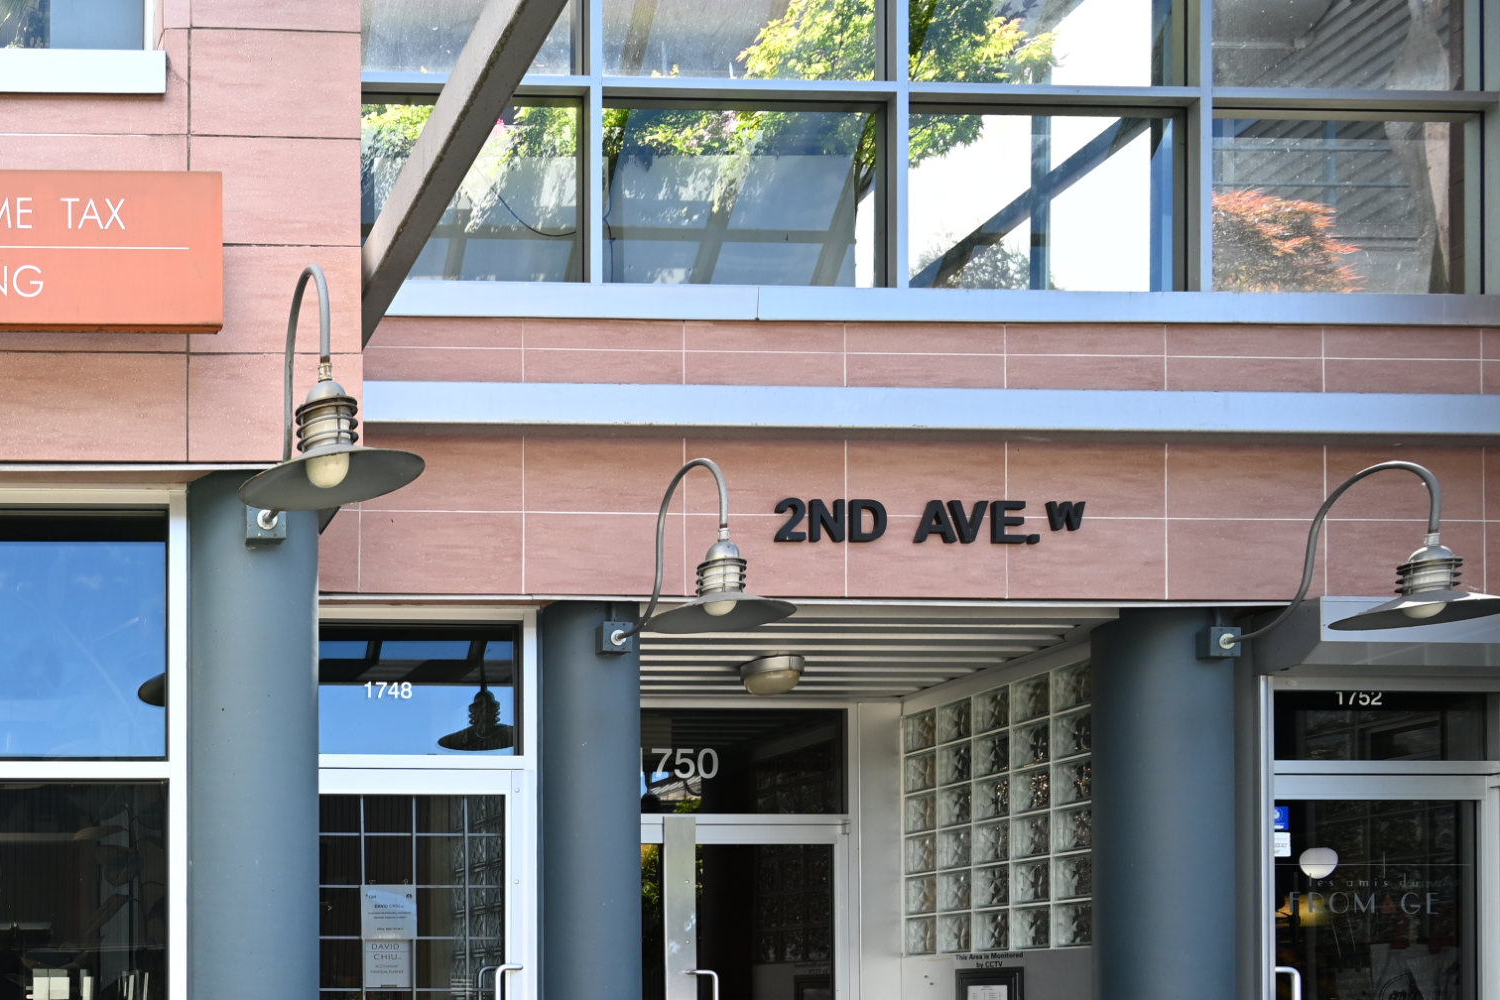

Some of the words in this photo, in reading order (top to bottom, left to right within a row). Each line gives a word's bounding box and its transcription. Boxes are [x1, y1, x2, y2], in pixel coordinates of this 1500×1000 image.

[59, 197, 126, 231] TAX
[773, 497, 888, 543] 2ND
[912, 499, 1041, 545] AVE.
[364, 680, 413, 699] 1748
[1335, 691, 1383, 706] 1752
[1308, 872, 1334, 888] les
[1346, 877, 1388, 888] amis
[1399, 872, 1421, 888] du
[969, 953, 983, 961] Area
[991, 952, 1024, 960] Monitored
